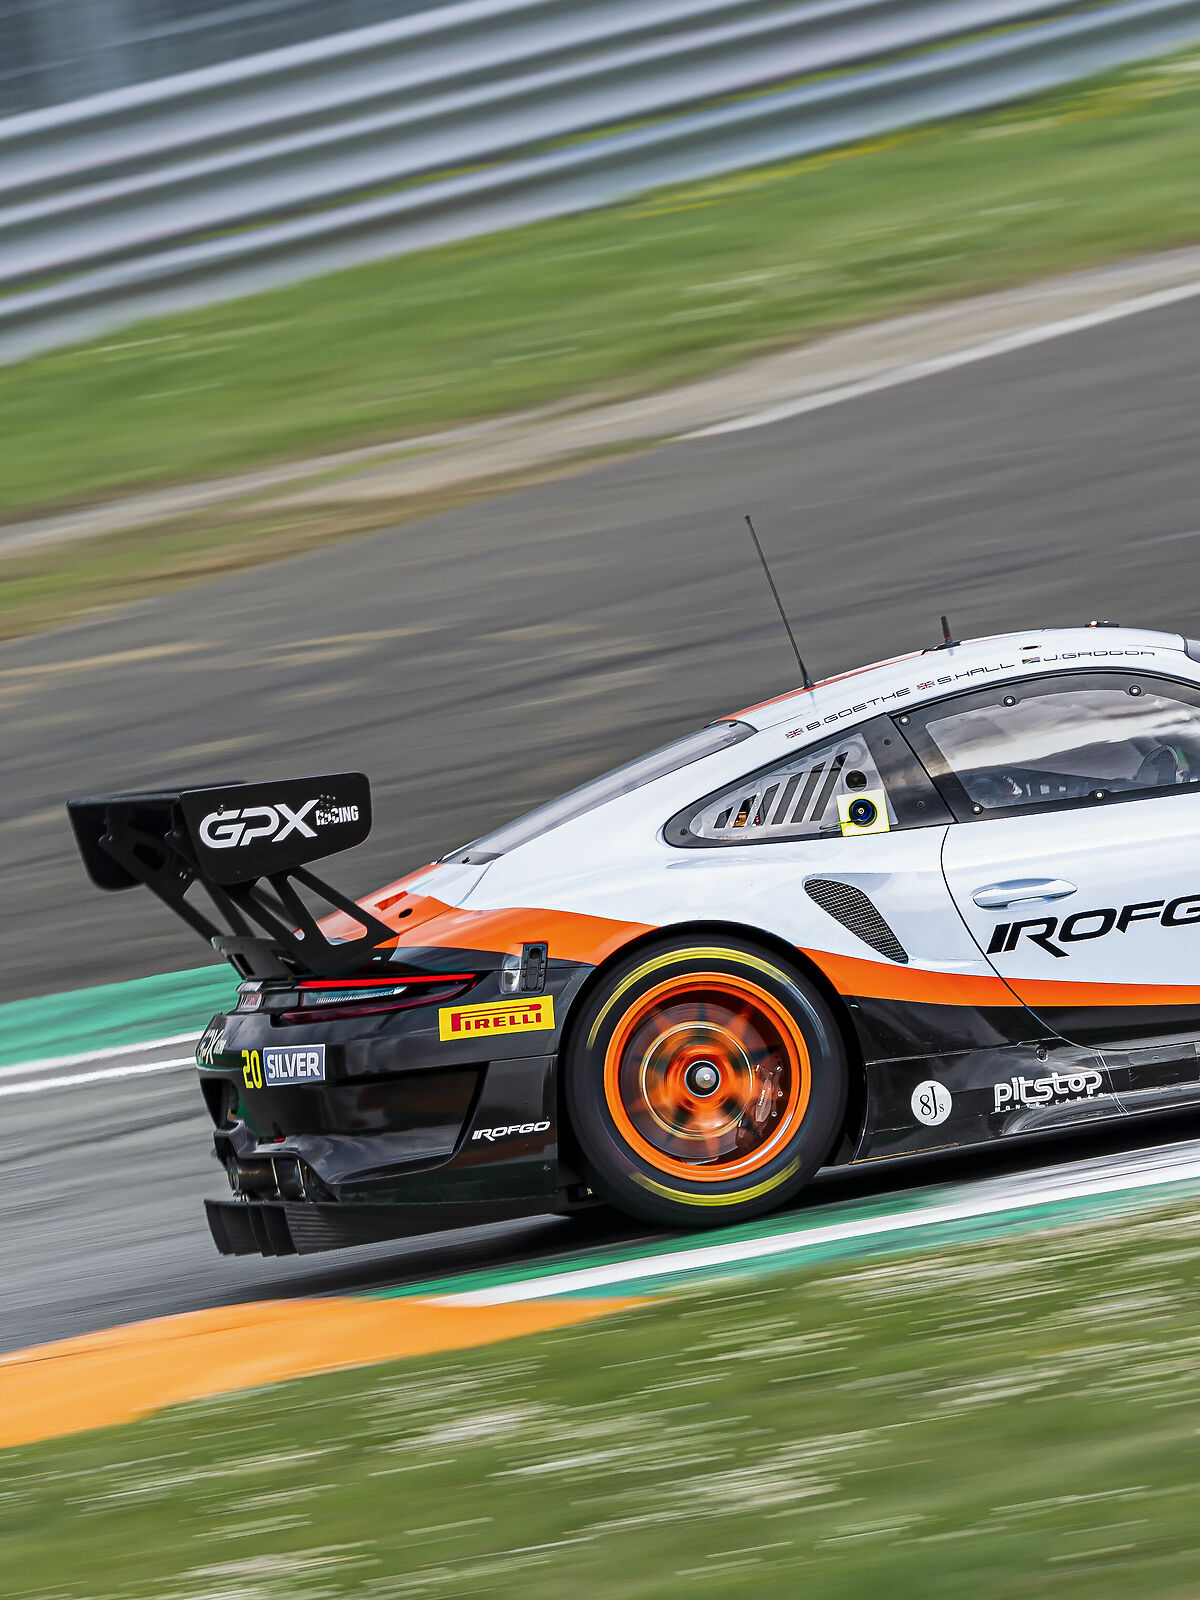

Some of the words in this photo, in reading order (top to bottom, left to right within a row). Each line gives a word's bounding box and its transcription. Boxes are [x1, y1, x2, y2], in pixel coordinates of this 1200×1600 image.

[937, 664, 1015, 685] S.HALL
[806, 687, 911, 731] B.GOETHE
[199, 799, 319, 849] GPX
[451, 1003, 542, 1032] PIRELLI
[241, 1049, 263, 1089] 20
[266, 1052, 320, 1079] SILVER
[994, 1071, 1103, 1107] pitstop
